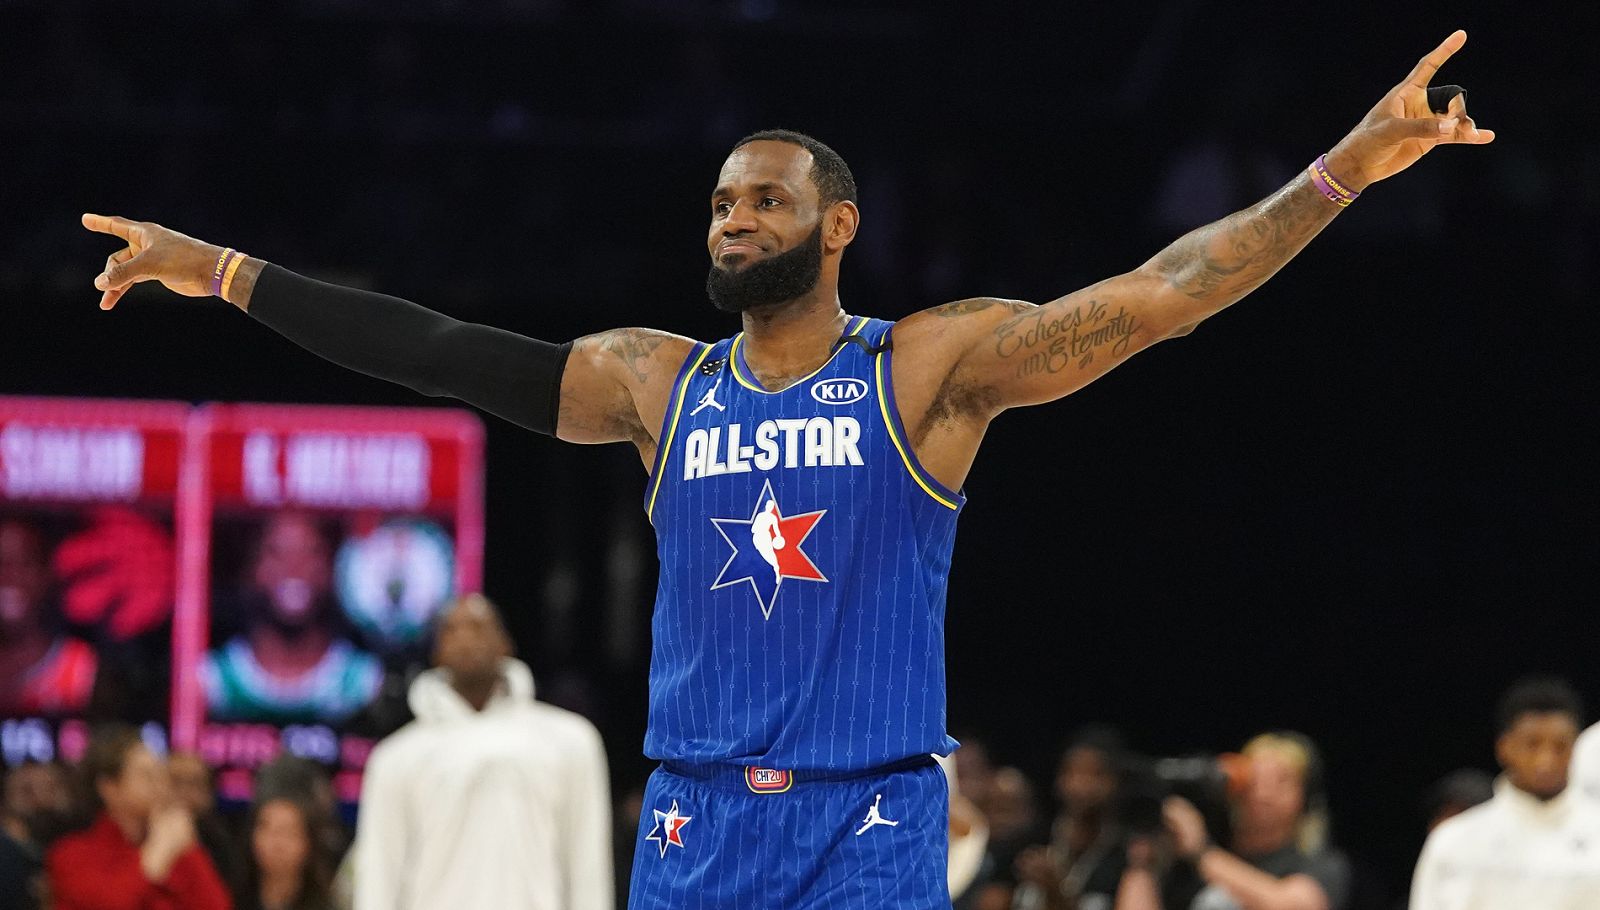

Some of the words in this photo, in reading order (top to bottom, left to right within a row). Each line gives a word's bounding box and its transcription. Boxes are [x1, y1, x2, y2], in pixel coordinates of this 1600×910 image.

[1321, 171, 1351, 197] PROMISE
[994, 306, 1082, 359] Echoes
[1046, 306, 1142, 374] Eternity
[821, 383, 860, 401] KIA
[683, 416, 865, 482] ALL-STAR
